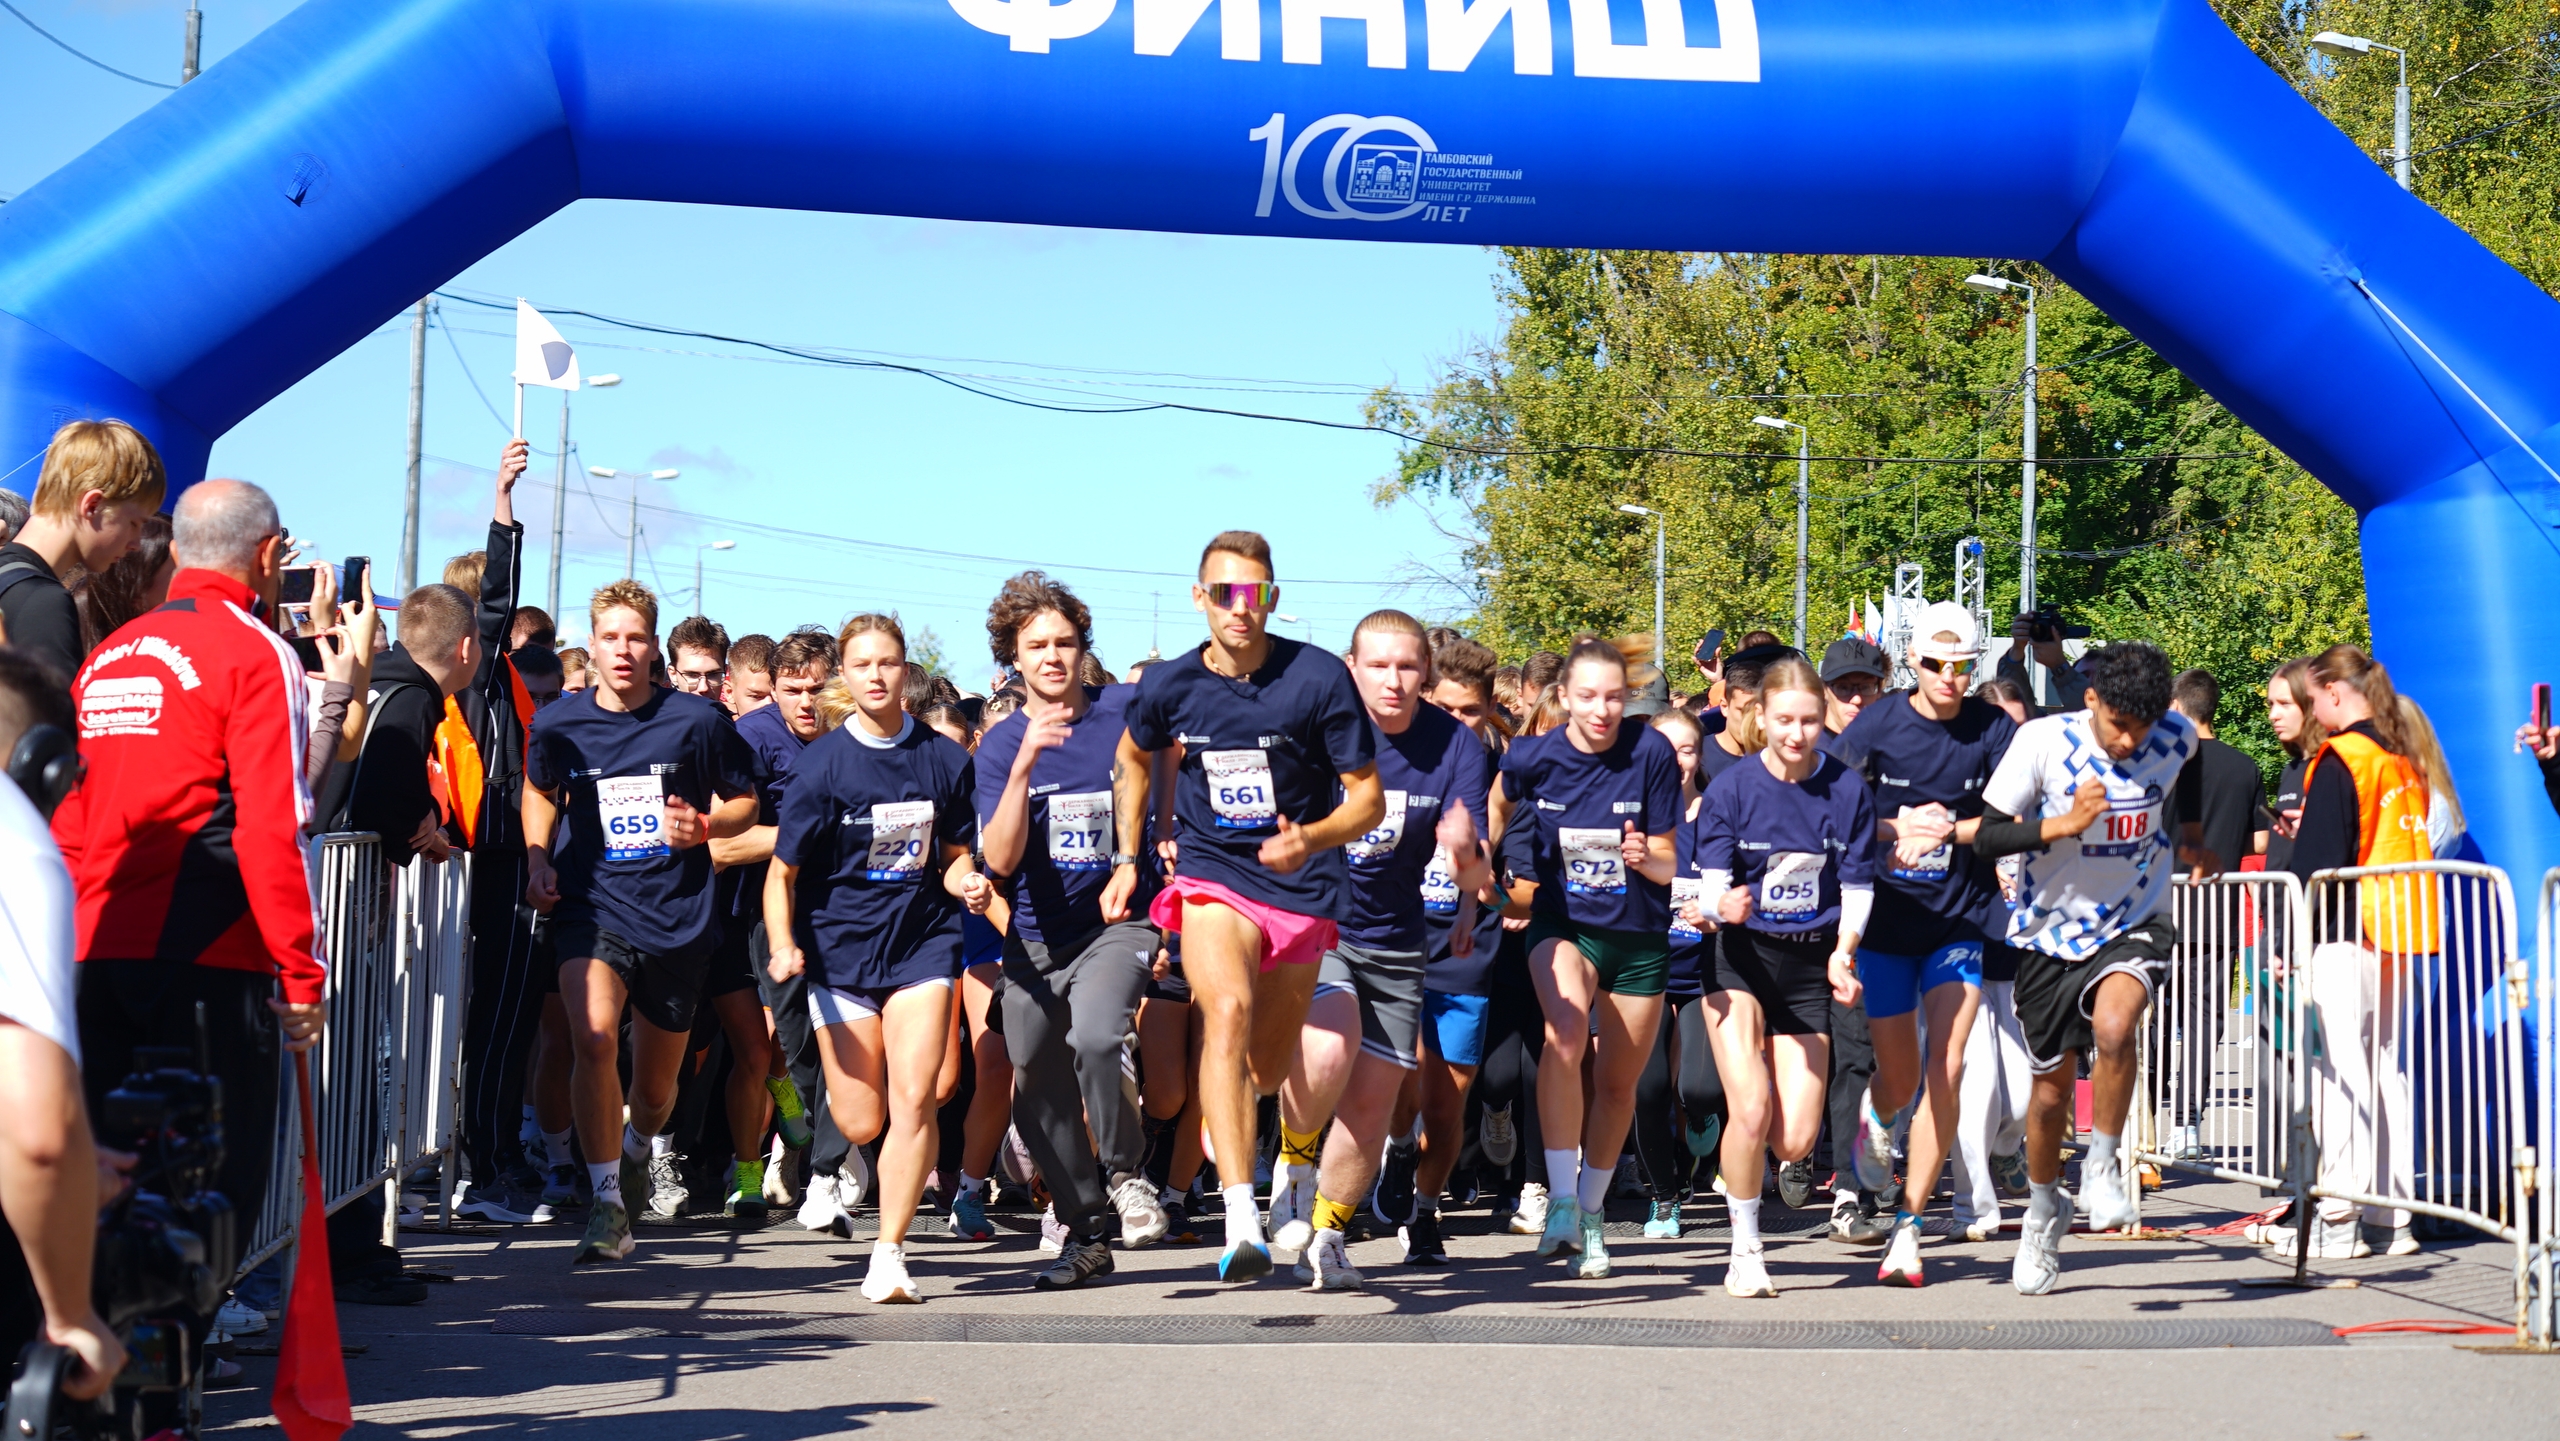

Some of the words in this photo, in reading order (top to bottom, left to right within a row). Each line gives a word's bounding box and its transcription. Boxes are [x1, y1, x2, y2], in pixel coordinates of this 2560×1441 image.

[1425, 152, 1493, 166] ТАМБОВСКИЙ
[1423, 166, 1523, 180] ГОСУДАРСТВЕННЫЙ
[1421, 180, 1492, 192] УНИВЕРСИТЕТ
[1419, 192, 1454, 202] ИМЕНИ
[1474, 194, 1537, 205] ДЕРЖАВИНА
[1422, 205, 1472, 223] ЛЕТ
[1220, 785, 1264, 805] 661
[609, 814, 658, 835] 659
[2104, 812, 2148, 841] 108
[1060, 829, 1103, 848] 217
[1354, 828, 1396, 845] 62
[874, 839, 924, 857] 220
[1571, 859, 1617, 875] 672
[1421, 871, 1455, 889] 52
[1770, 881, 1814, 900] 055
